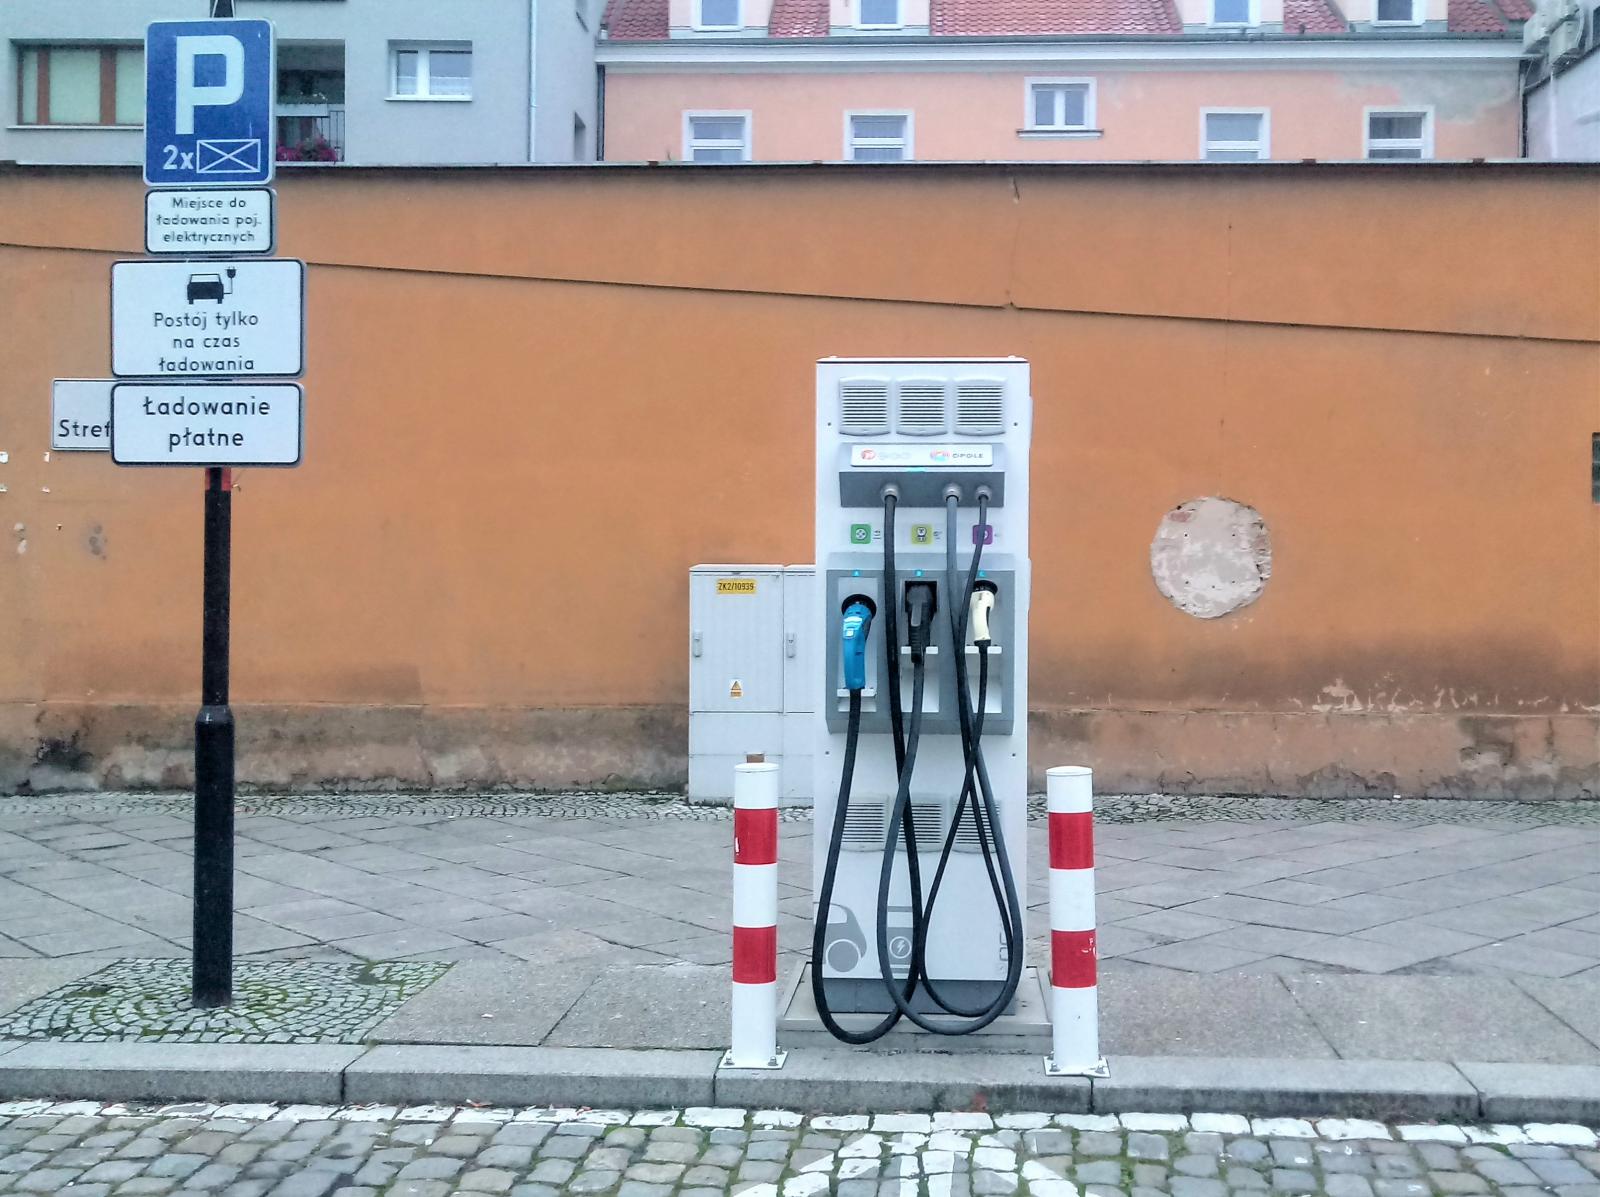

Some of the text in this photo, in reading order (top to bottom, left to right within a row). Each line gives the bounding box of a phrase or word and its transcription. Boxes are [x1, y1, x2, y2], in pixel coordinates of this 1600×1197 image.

[175, 35, 245, 135] P
[163, 145, 194, 171] 2x
[172, 196, 247, 210] Miejsce do
[156, 213, 262, 227] ładowania poj.
[163, 231, 255, 245] elektrycznych
[153, 311, 259, 330] Postój tylko
[173, 337, 240, 348] na czas
[158, 355, 255, 371] ładowania
[143, 396, 271, 416] Ładowanie
[168, 427, 244, 452] płatne
[718, 582, 754, 591] ZK2/10939
